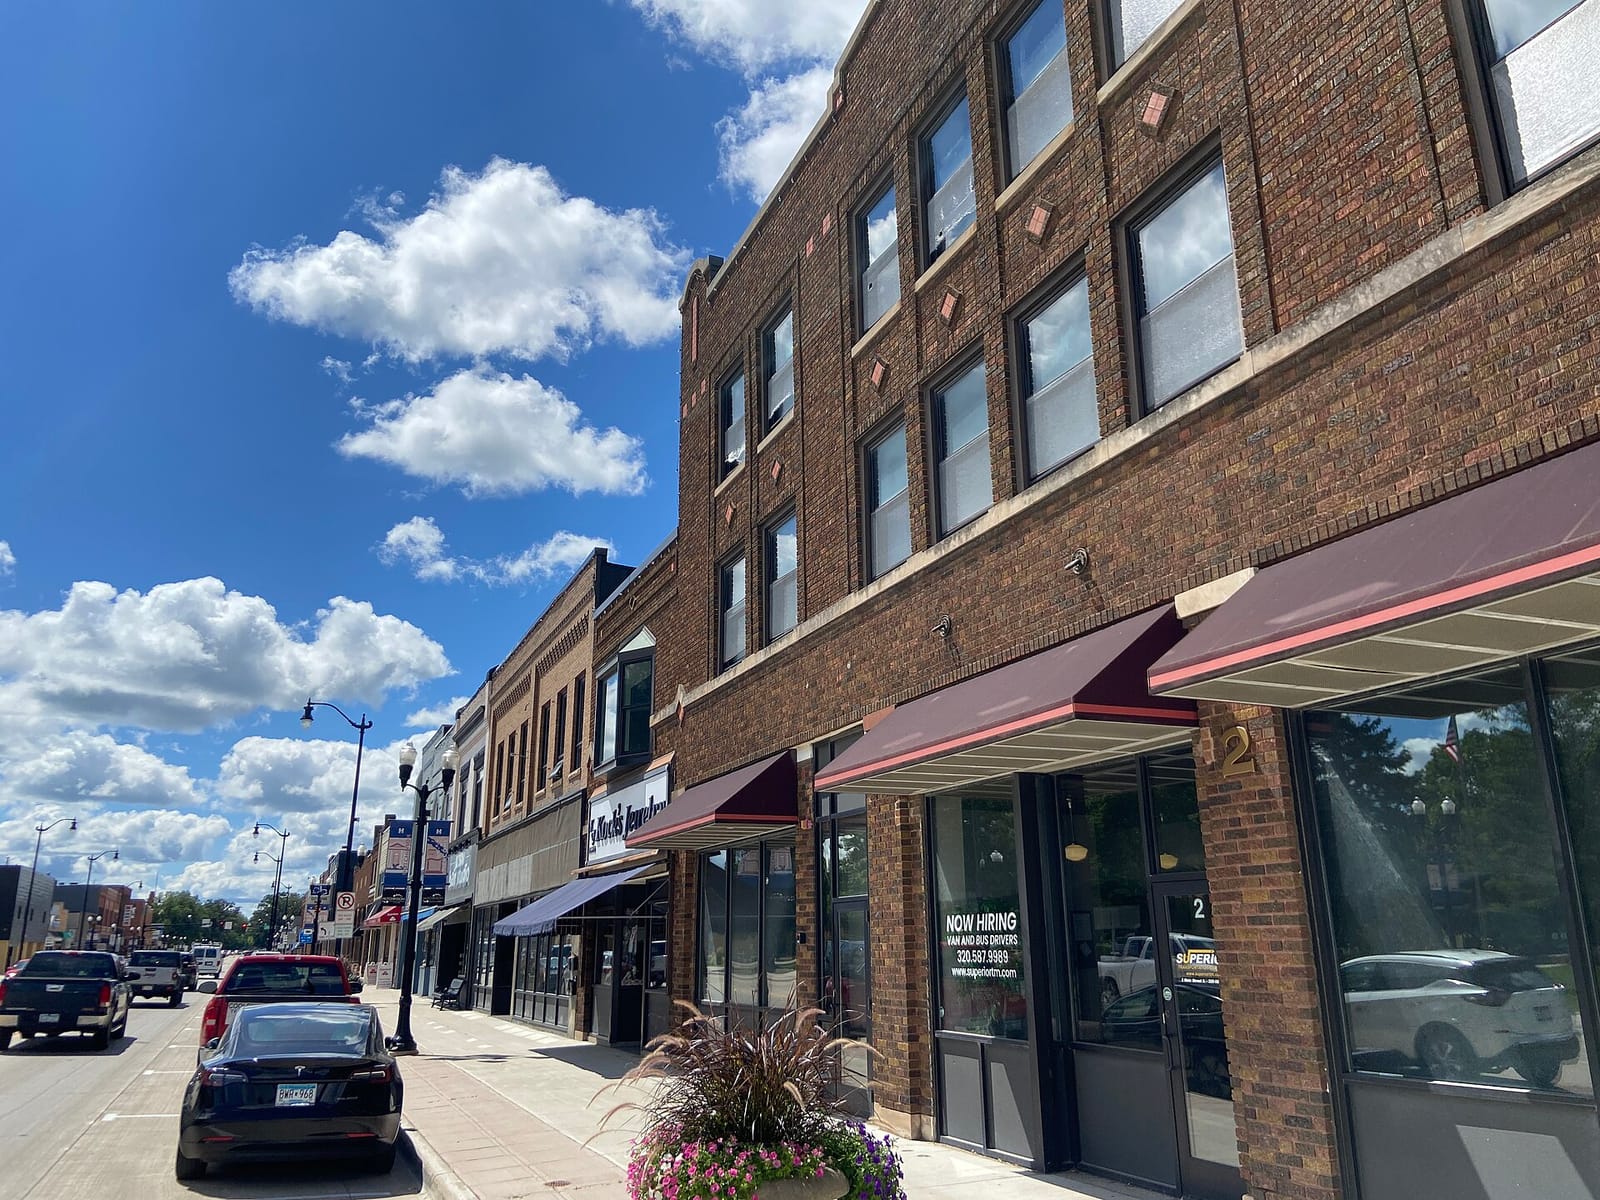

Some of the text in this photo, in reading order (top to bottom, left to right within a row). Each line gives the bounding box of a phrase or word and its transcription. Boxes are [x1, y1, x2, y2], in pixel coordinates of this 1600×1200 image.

[1222, 726, 1255, 778] 2
[1193, 897, 1205, 919] 2
[946, 912, 1017, 932] NOW HIRING
[946, 934, 1018, 946] VAN AND BUS DRIVERS
[956, 950, 1009, 964] 320.587.9989
[951, 966, 1017, 980] www.superiortm.com
